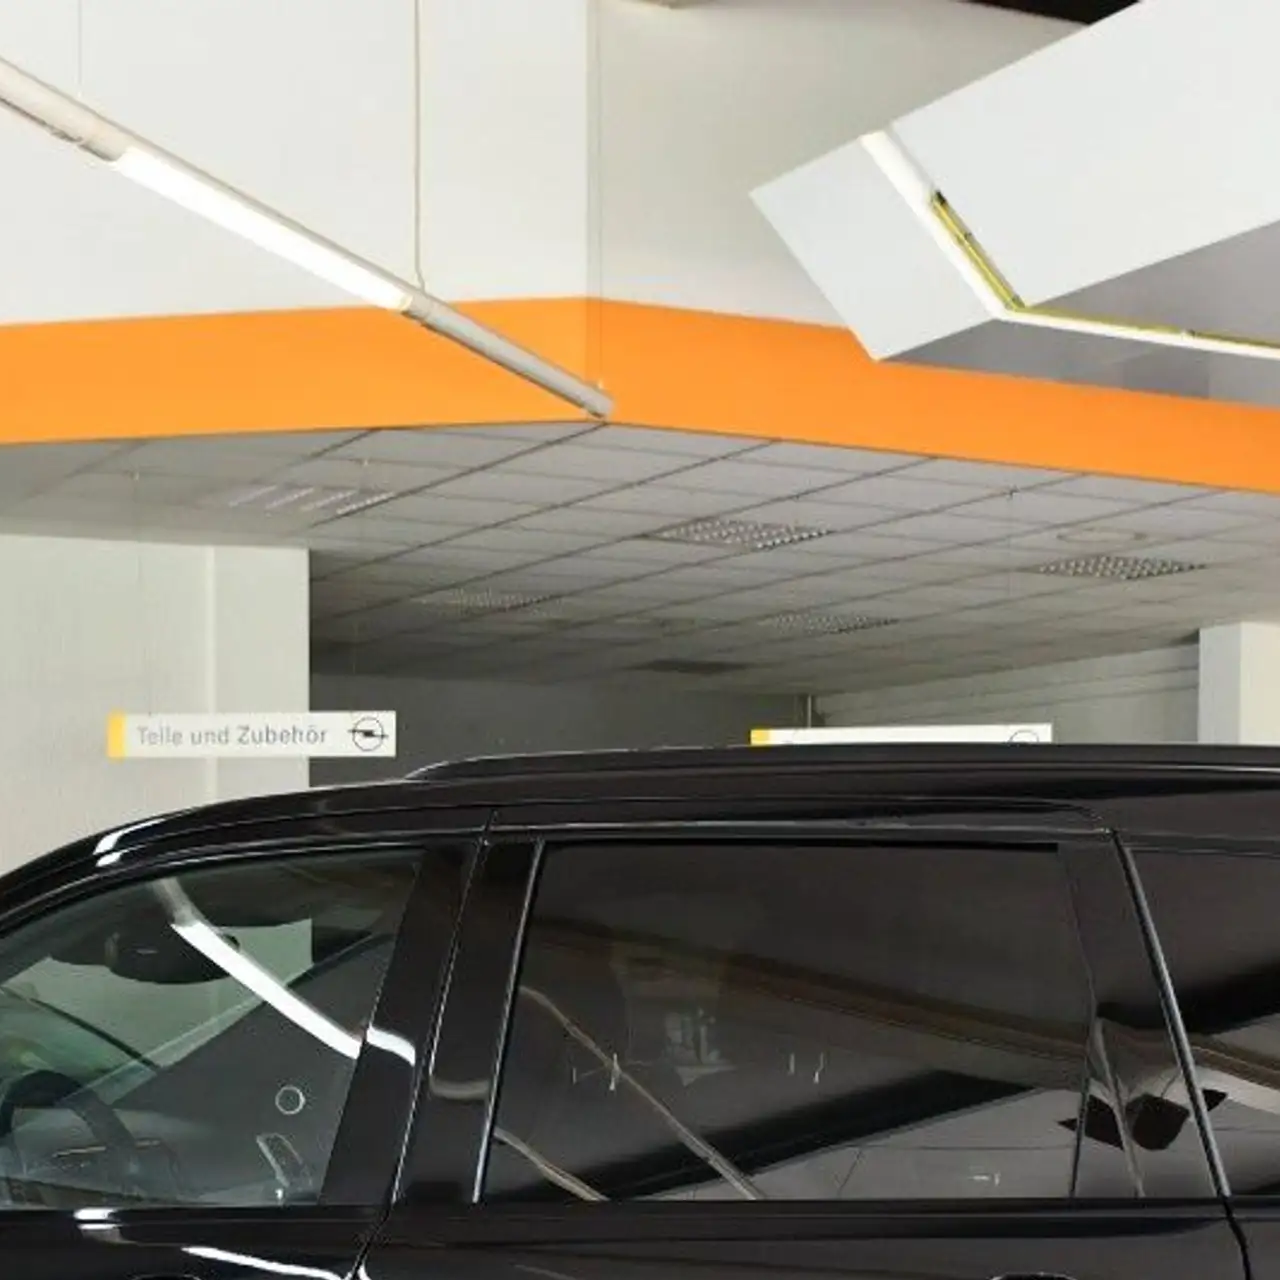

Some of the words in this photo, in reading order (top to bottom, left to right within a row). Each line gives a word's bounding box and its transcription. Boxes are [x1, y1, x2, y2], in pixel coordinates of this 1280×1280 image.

[137, 725, 183, 746] Teile
[190, 726, 230, 746] und
[236, 724, 328, 747] Zubehör
